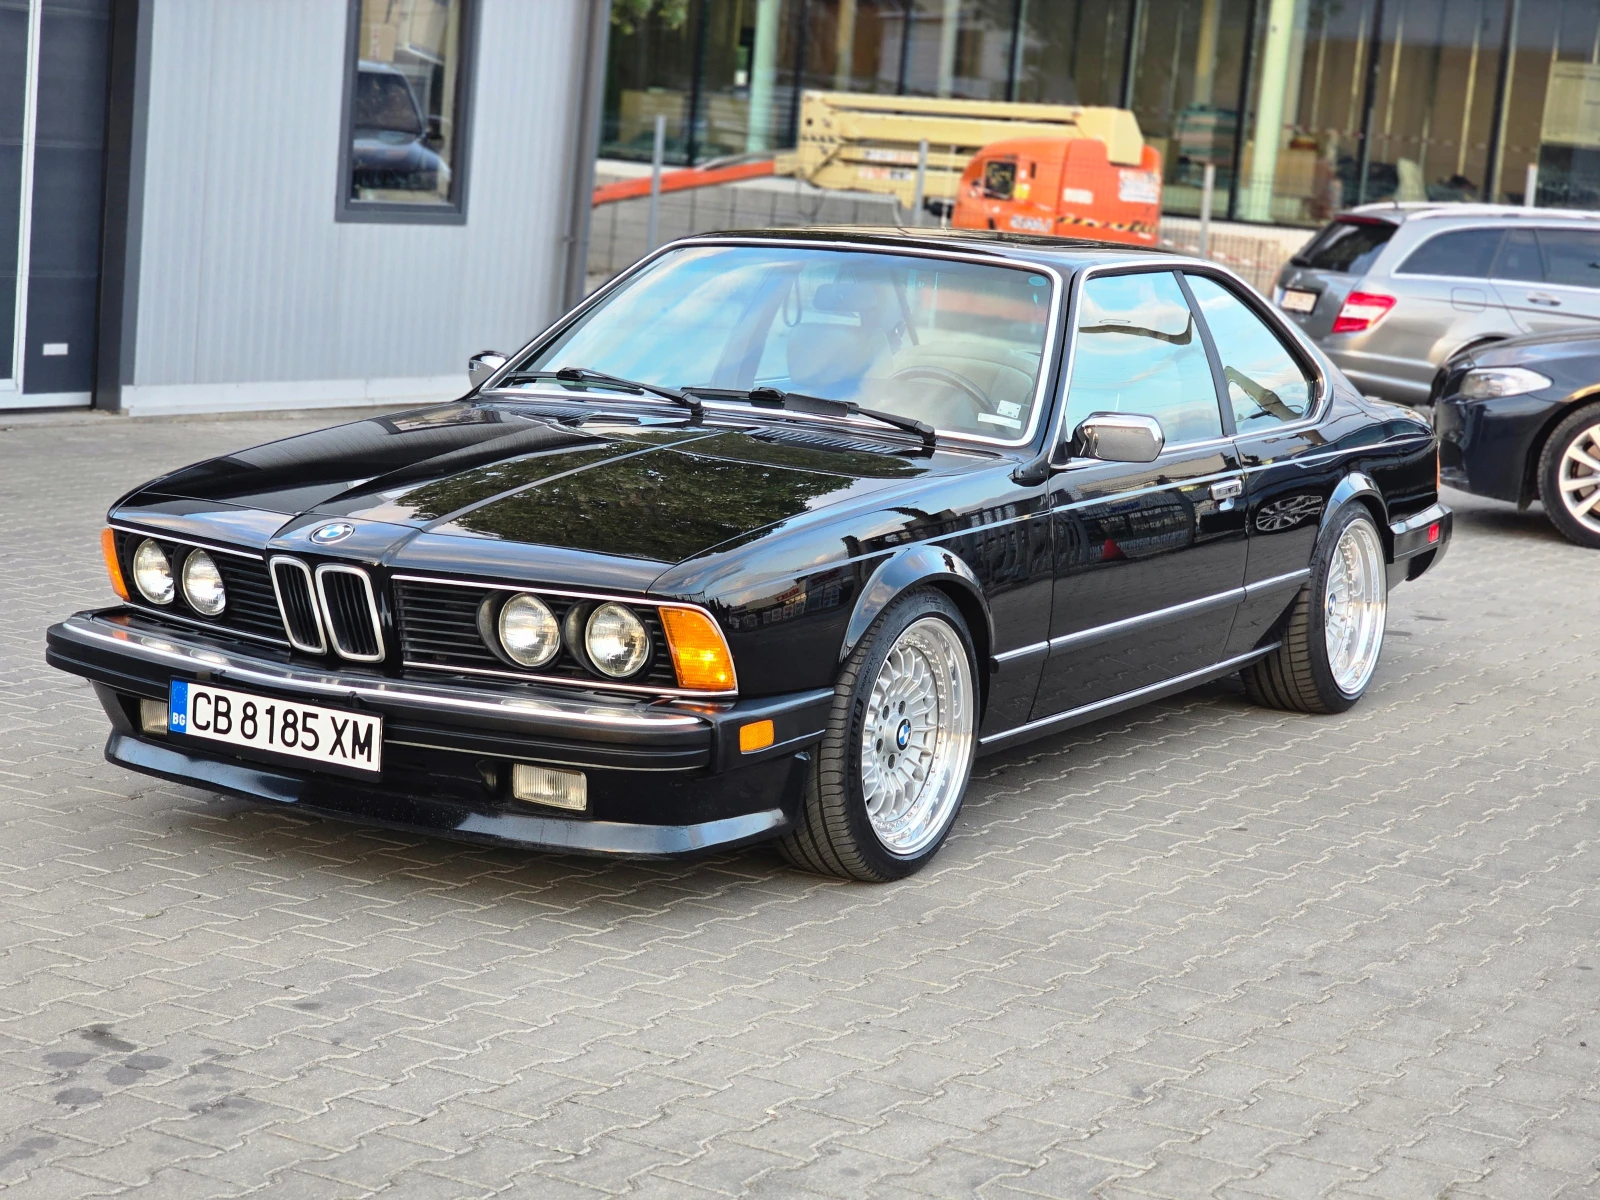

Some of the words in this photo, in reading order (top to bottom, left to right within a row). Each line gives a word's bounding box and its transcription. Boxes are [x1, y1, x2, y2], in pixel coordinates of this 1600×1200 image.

[172, 711, 186, 726] BG
[192, 692, 232, 735] CB
[240, 701, 320, 752] 8185
[328, 716, 374, 763] XM
